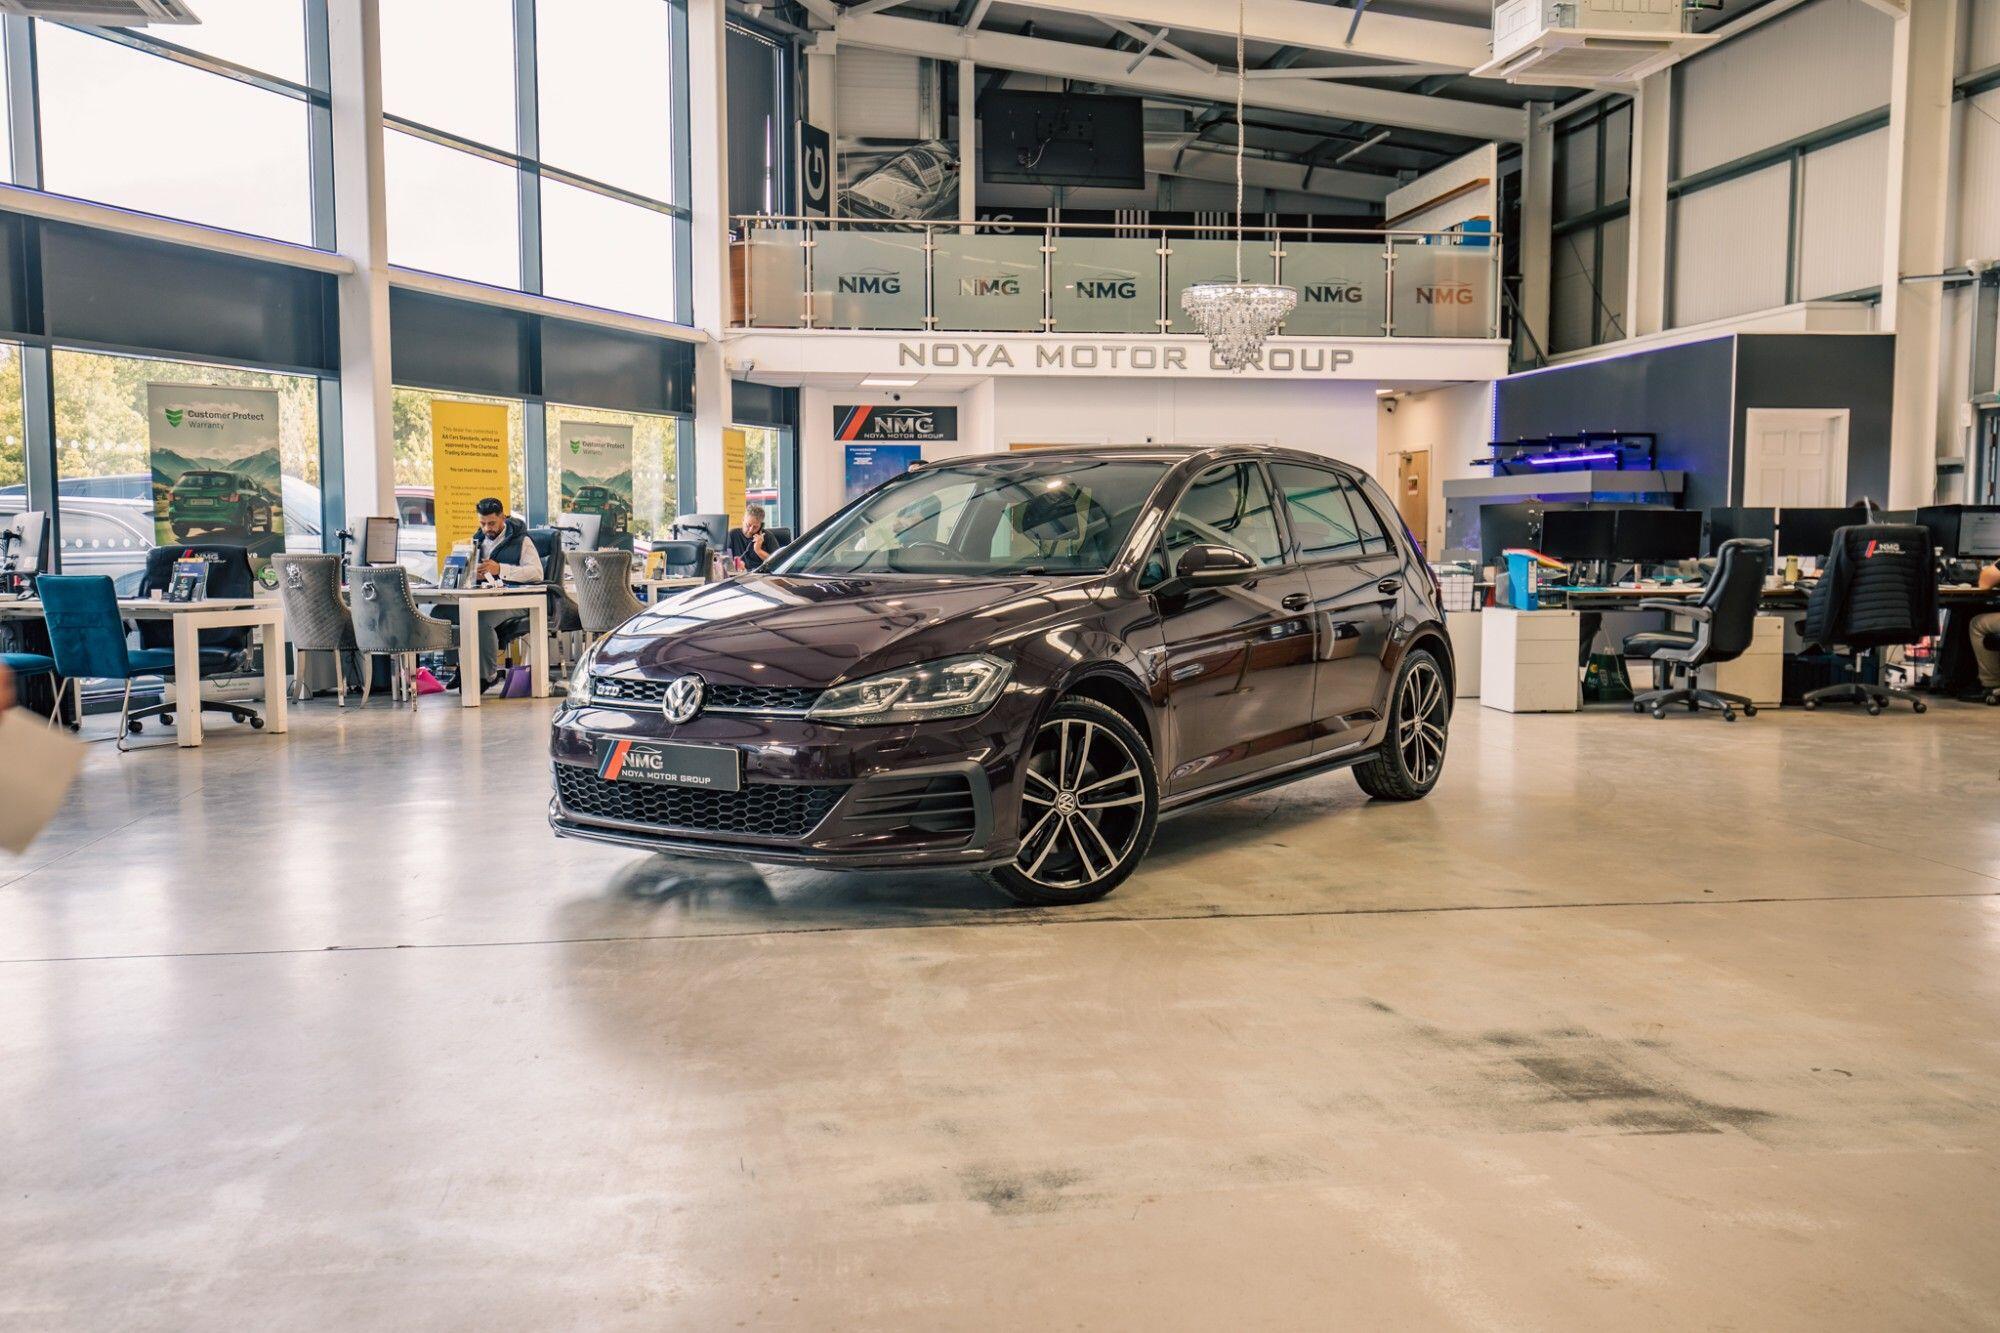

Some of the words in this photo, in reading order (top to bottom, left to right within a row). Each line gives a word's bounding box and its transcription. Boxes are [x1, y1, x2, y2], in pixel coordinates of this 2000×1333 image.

[838, 276, 900, 294] NMG
[958, 279, 1020, 296] NMG
[1076, 281, 1136, 299] NMG
[1305, 286, 1363, 303] NMG
[1416, 287, 1473, 304] NMG
[899, 343, 1015, 368] NOYA
[1036, 345, 1188, 369] MOTOR
[188, 410, 231, 420] Customer
[232, 411, 265, 421] Protect
[188, 421, 225, 430] Warranty
[874, 416, 934, 433] NMG
[596, 684, 620, 696] GTD
[622, 752, 664, 769] NMG
[621, 769, 645, 778] NOYA
[647, 772, 678, 781] MOTOR
[680, 775, 711, 784] GROUP
